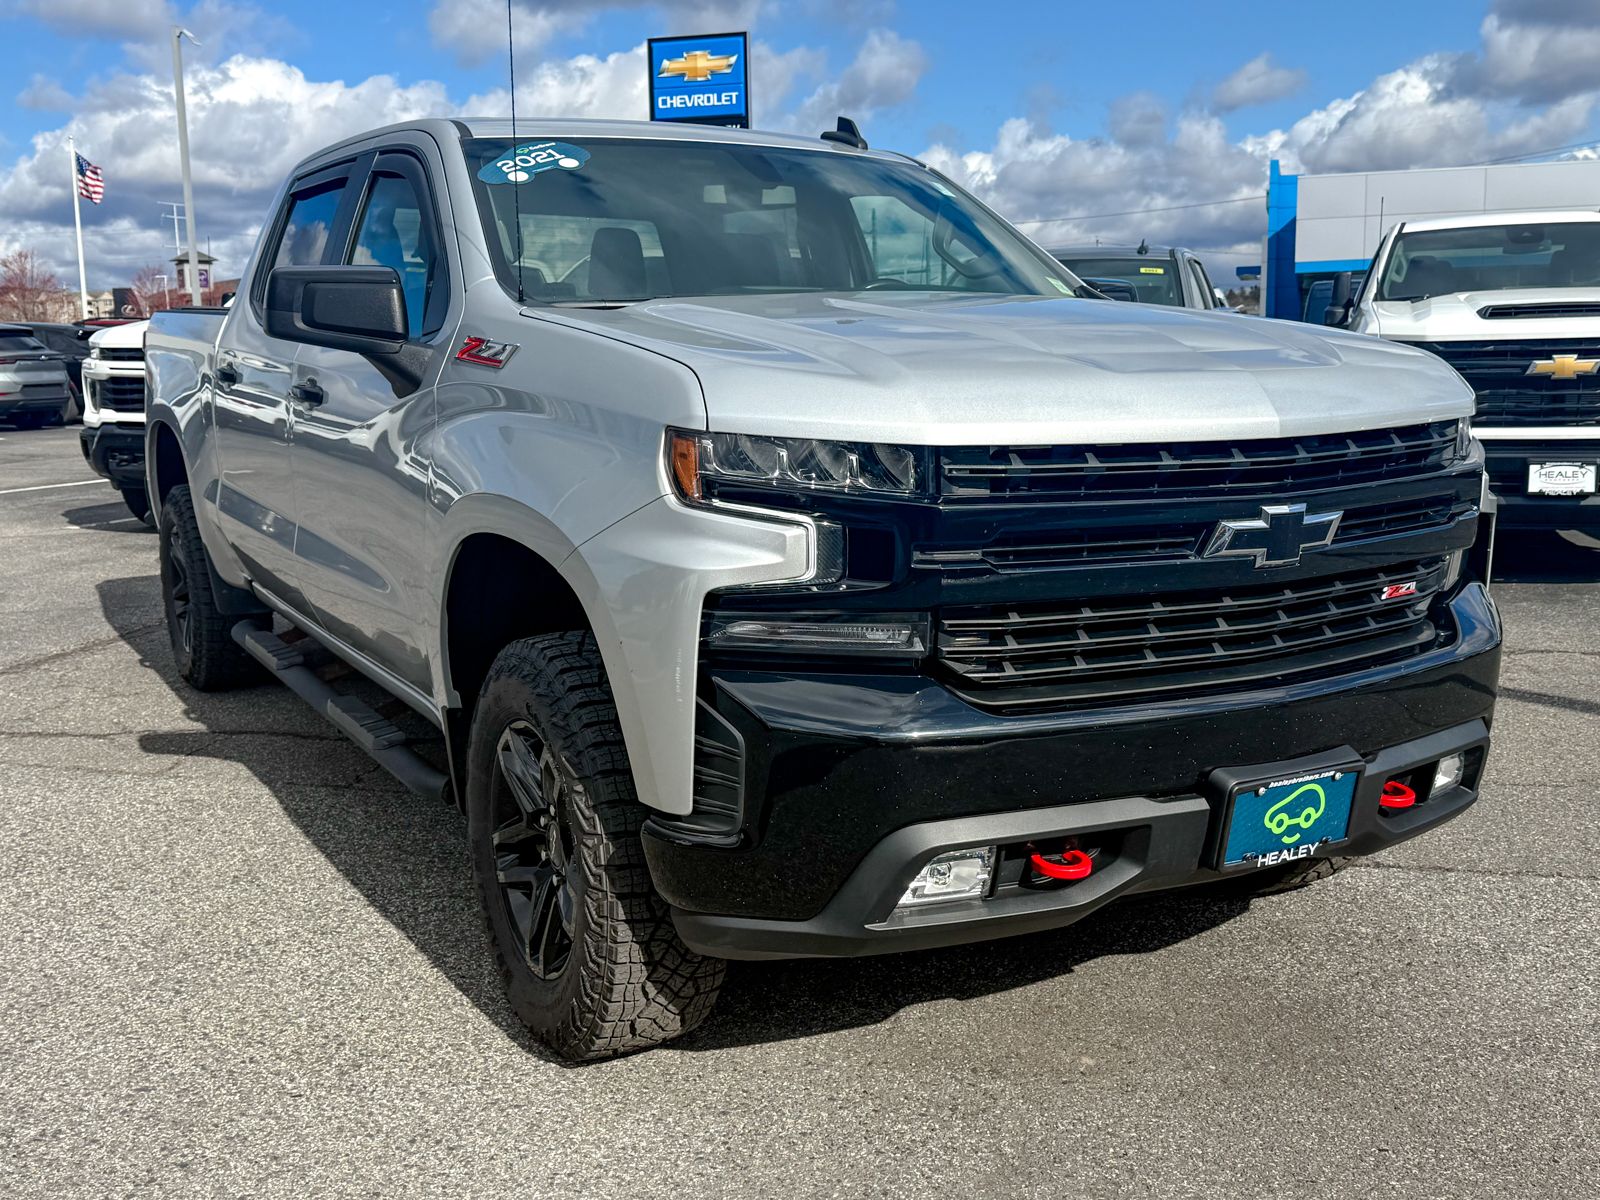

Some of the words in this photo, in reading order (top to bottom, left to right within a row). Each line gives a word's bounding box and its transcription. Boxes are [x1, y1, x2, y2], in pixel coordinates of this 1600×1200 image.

[658, 92, 739, 109] CHEVROLET
[496, 149, 565, 173] 2021
[1539, 470, 1588, 479] HEALEY
[1268, 770, 1336, 788] healeybrothers.com
[1257, 842, 1319, 868] HEALEY
